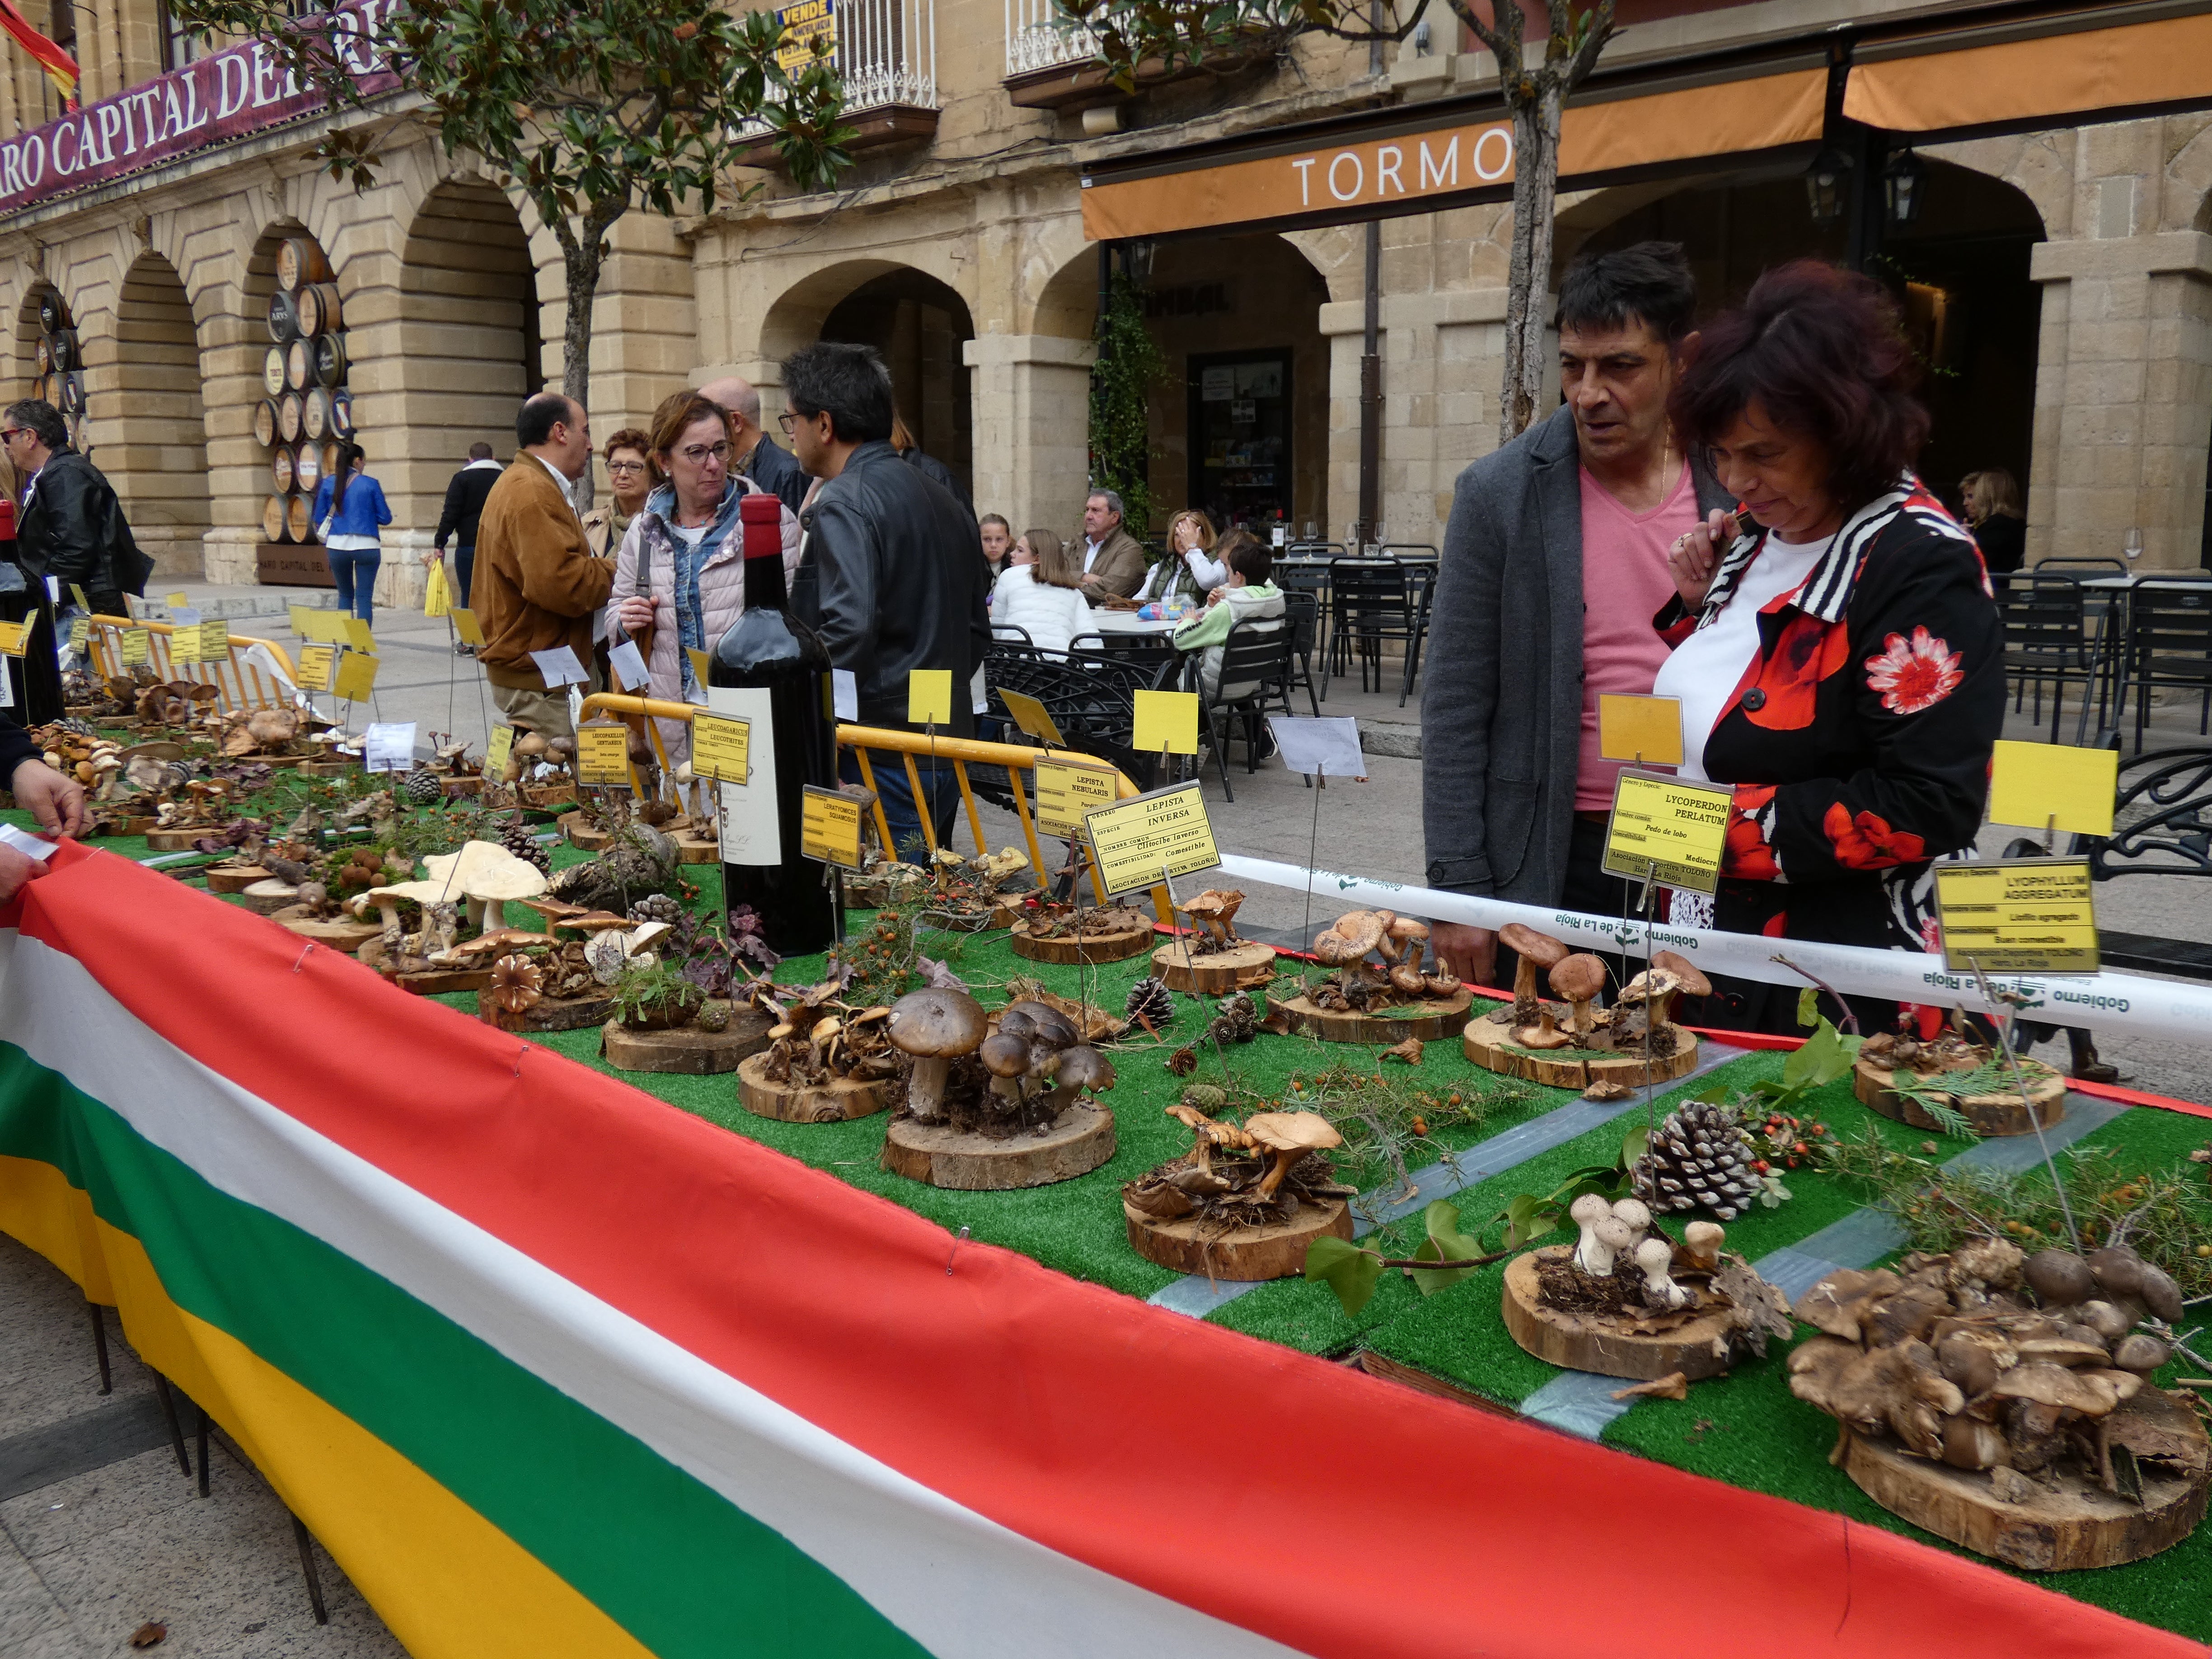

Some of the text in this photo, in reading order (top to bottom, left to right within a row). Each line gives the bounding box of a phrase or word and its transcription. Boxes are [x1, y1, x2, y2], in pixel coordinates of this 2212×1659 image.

[782, 0, 828, 25] VENDE
[52, 71, 208, 175] CAPITAL
[1292, 128, 1513, 206] TORMO
[708, 723, 748, 735] LEUCOAGARICUS
[710, 734, 744, 745] LEUCOTHITES
[1077, 776, 1104, 787] LEPISTA
[1643, 782, 1661, 790] Especie:
[1072, 784, 1108, 797] NEBULARIS
[824, 803, 857, 816] LERATYOMICES
[1146, 796, 1184, 812] LEPISTA
[1666, 795, 1728, 813] LYCOPERDON
[829, 812, 856, 824] SQUAMOSUS
[1148, 809, 1190, 826] INVERSA
[1616, 810, 1634, 818] Nombre
[1675, 809, 1725, 825] PERLATUM
[1040, 820, 1067, 829] ASOCIACIÓN
[1097, 826, 1120, 835] ESPECIE
[1173, 830, 1199, 840] inverso
[1612, 830, 1647, 842] Comestibilidad:
[1645, 825, 1661, 833] Pedo
[1673, 830, 1687, 839] lobo
[1104, 842, 1127, 852] NOMBRE
[1165, 841, 1205, 857] Comestible
[1612, 851, 1645, 863] Asociación
[1682, 866, 1711, 878] TOLOÑO
[1685, 854, 1717, 866] Mediocre
[1111, 875, 1150, 889] ASOCIACION
[1190, 857, 1215, 868] TOLOÑO
[1664, 872, 1681, 882] Rioja
[2006, 876, 2088, 887] LYOPHYLLUM
[2004, 889, 2088, 900] AGGREGATUM
[1556, 914, 1698, 949] Gobierno de La Rioja
[1994, 936, 2066, 944] Buen comestible
[1923, 972, 1960, 990] Rioja
[2053, 990, 2130, 1013] Gobierno
